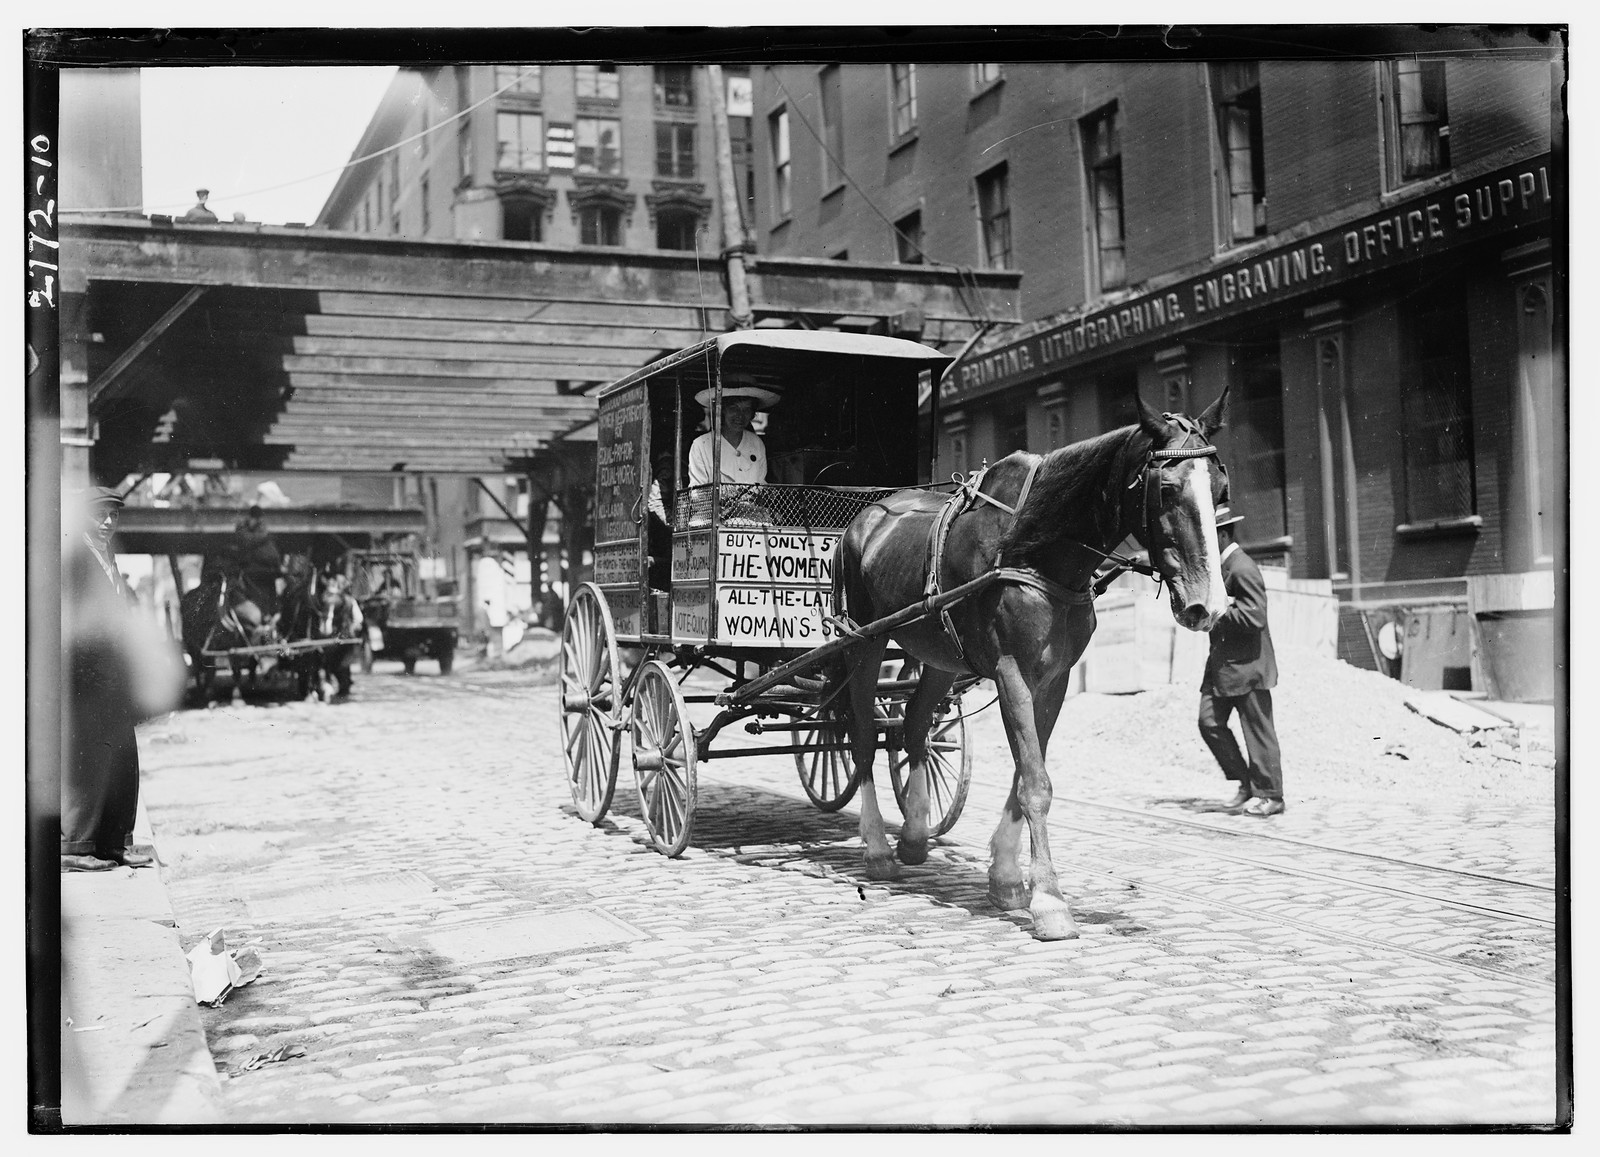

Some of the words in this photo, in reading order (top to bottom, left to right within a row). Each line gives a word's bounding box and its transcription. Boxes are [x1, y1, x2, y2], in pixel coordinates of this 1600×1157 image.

[1039, 293, 1185, 363] LITHOGRAPHING.
[1193, 243, 1332, 312] ENGRAVING.
[1344, 203, 1444, 263] OFFICE
